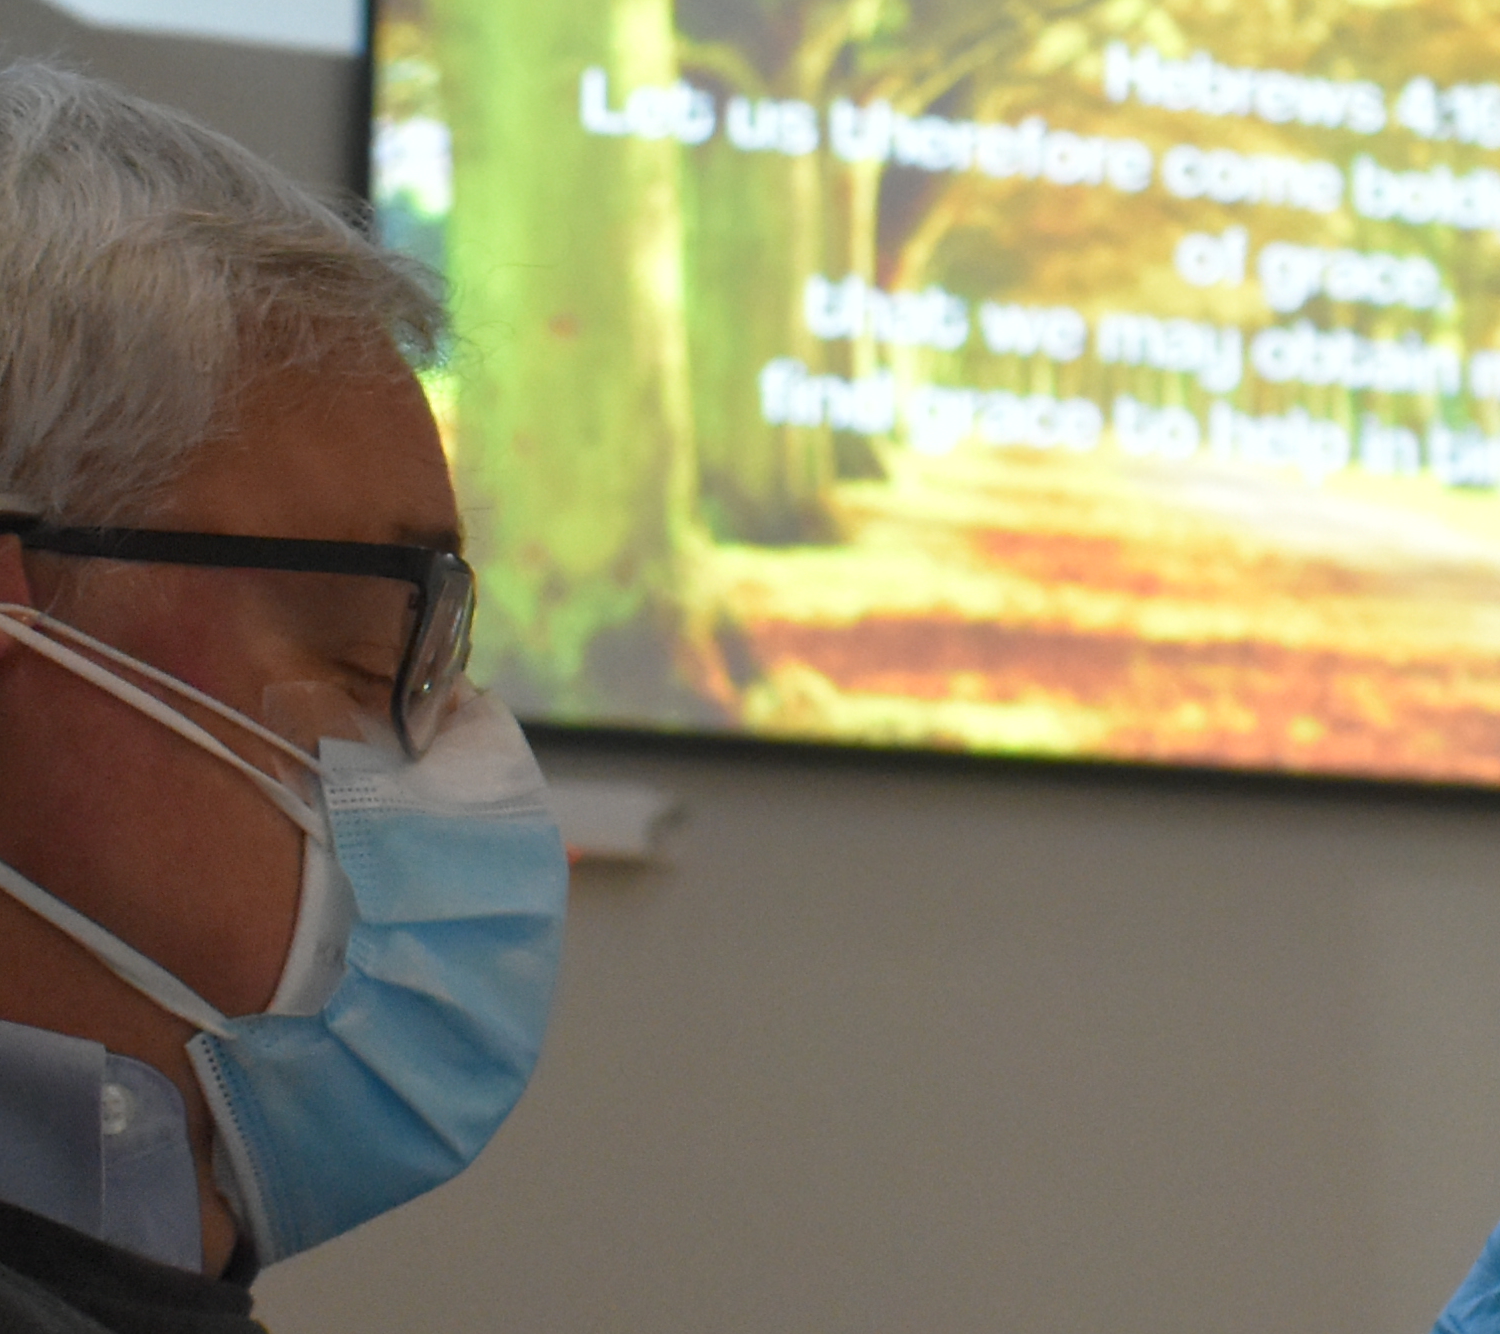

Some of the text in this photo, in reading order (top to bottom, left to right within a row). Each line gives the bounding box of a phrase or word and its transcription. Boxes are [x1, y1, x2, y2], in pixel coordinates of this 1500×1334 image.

[580, 65, 716, 145] Let
[725, 95, 820, 156] us
[827, 95, 1152, 193] therefore
[1162, 143, 1344, 213] come
[1104, 40, 1387, 134] Hebrews
[1173, 224, 1248, 288] of
[803, 272, 969, 352] that
[979, 300, 1088, 361] we
[1097, 311, 1243, 394] may
[1251, 318, 1461, 397] obtain
[758, 356, 897, 436] find
[907, 384, 1102, 457] grace
[1113, 394, 1199, 460] to
[1208, 398, 1351, 487] help
[1359, 413, 1421, 475] in
